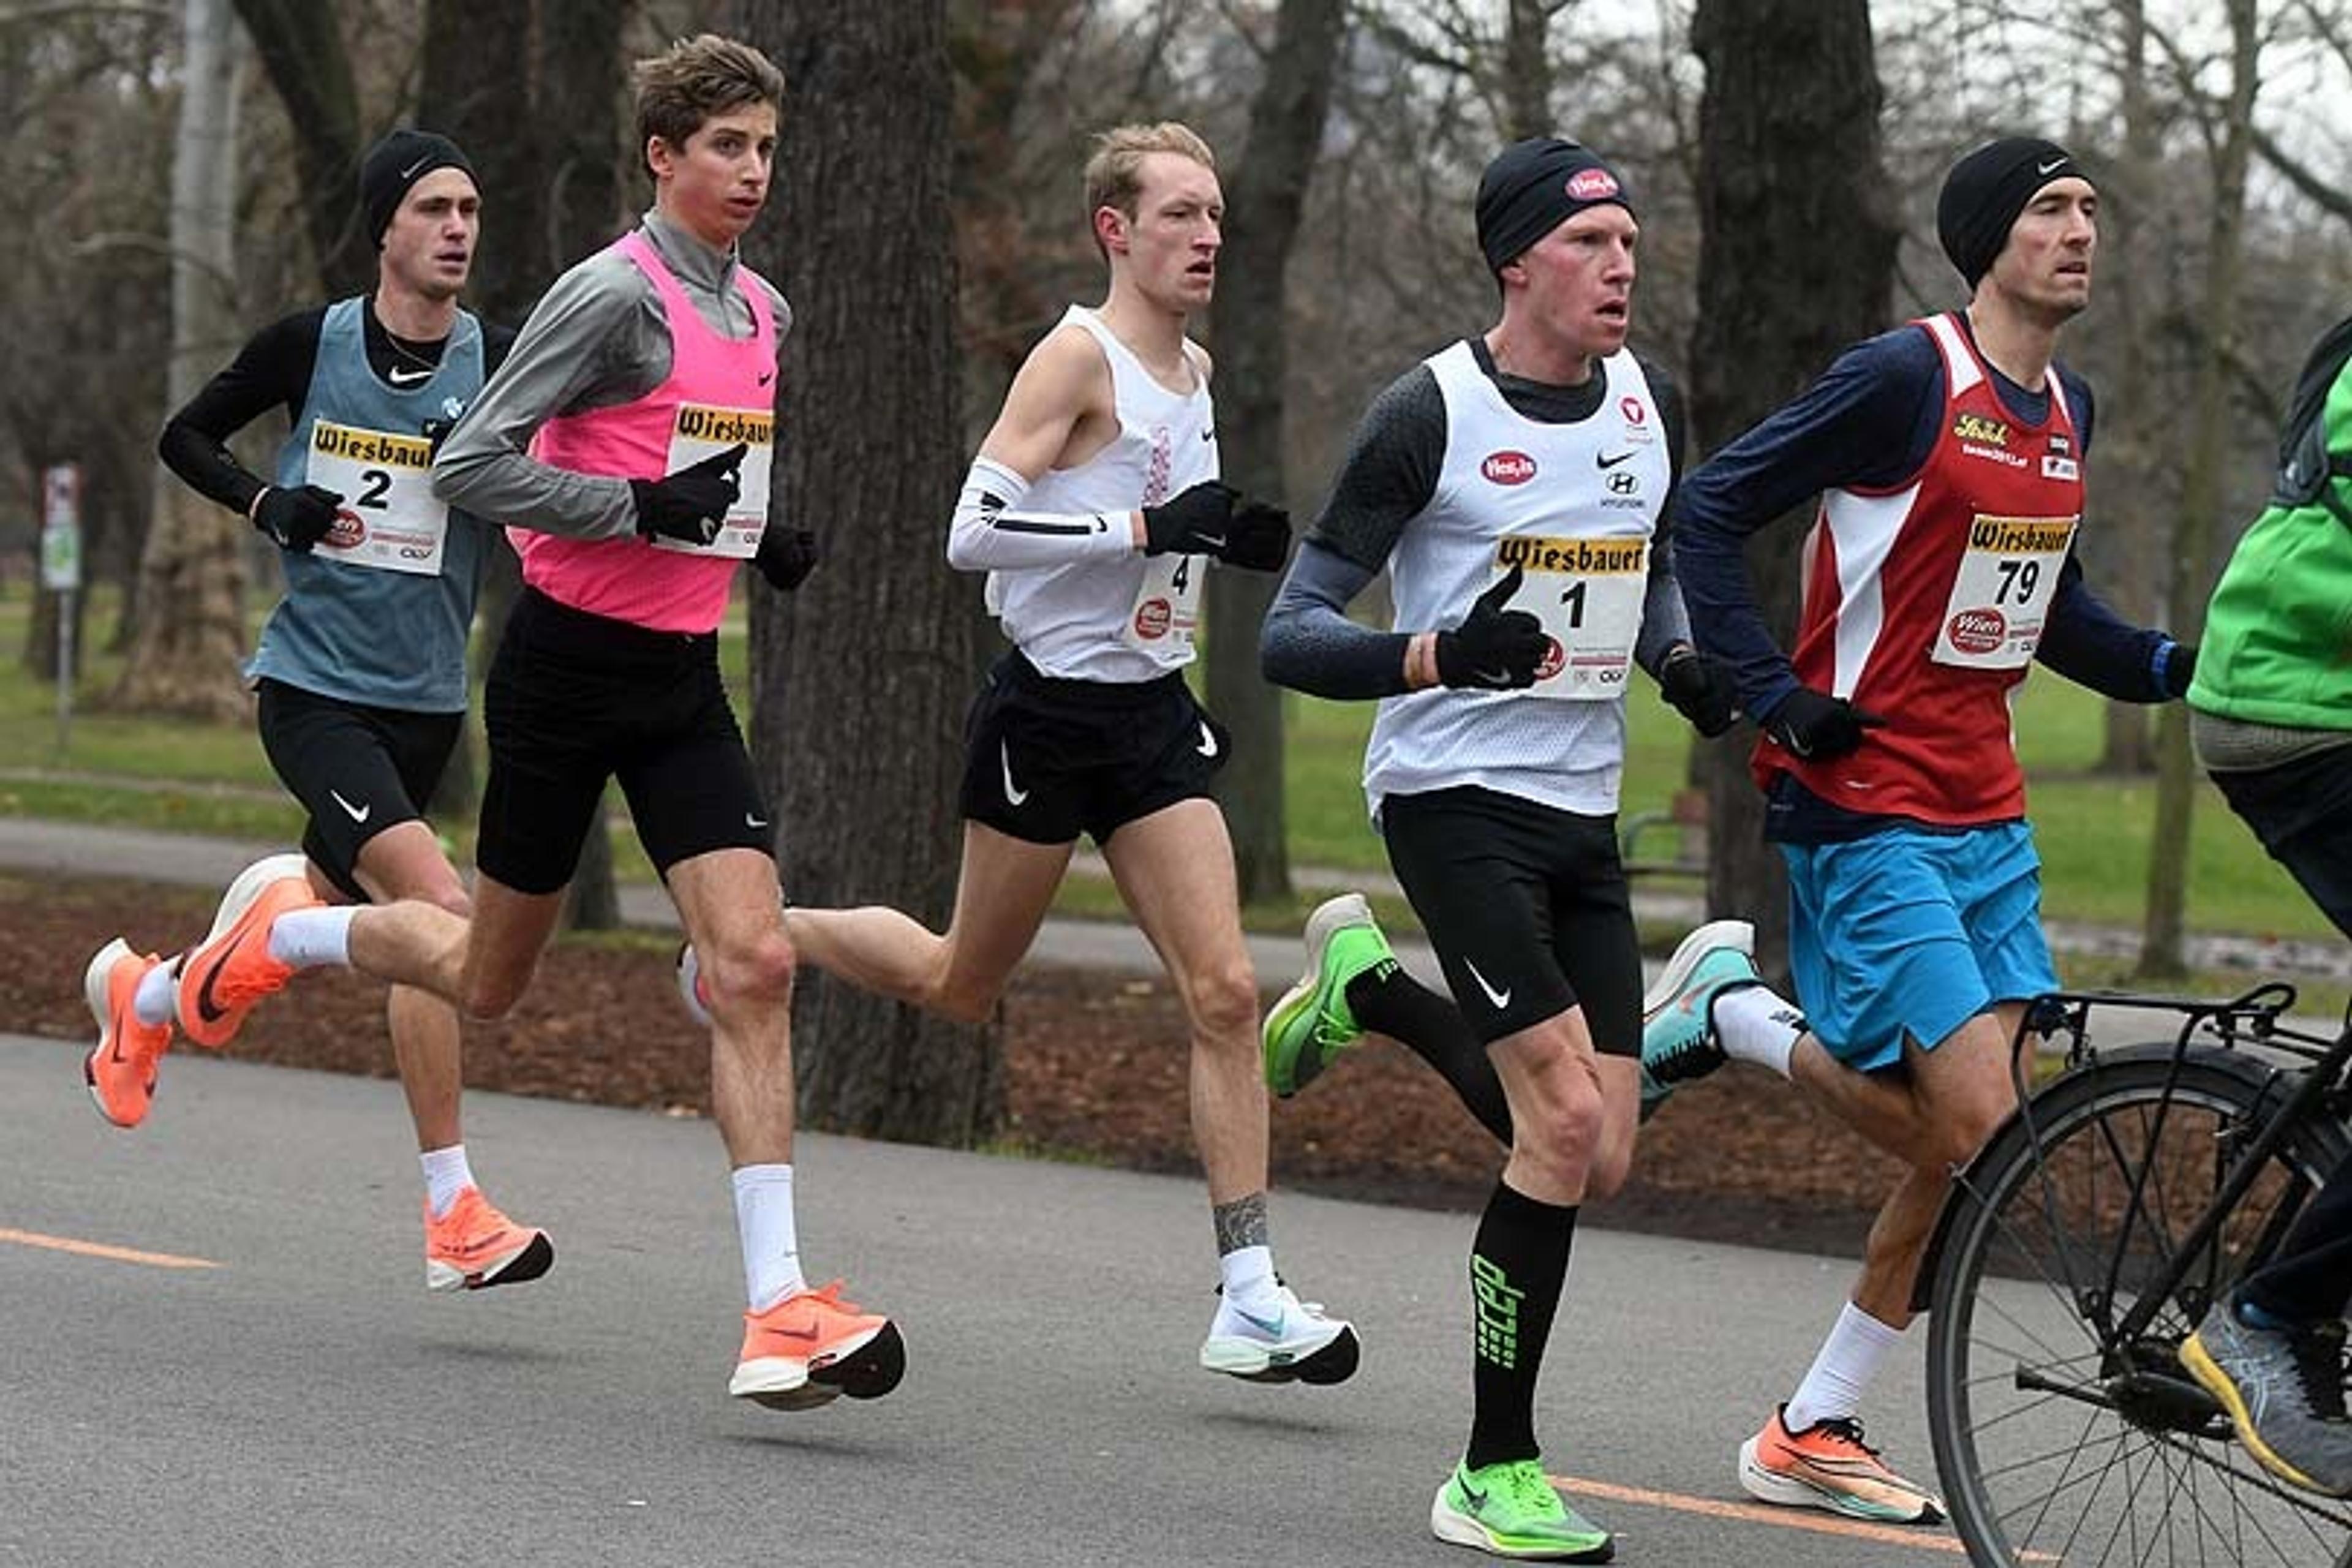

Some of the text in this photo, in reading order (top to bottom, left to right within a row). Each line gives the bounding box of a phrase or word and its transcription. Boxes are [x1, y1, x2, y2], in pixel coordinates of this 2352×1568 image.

[356, 470, 393, 510] 2
[1172, 554, 1189, 595] 4
[1498, 539, 1643, 571] Wiesbauer
[1995, 560, 2040, 605] 79
[1560, 581, 1588, 628] 1
